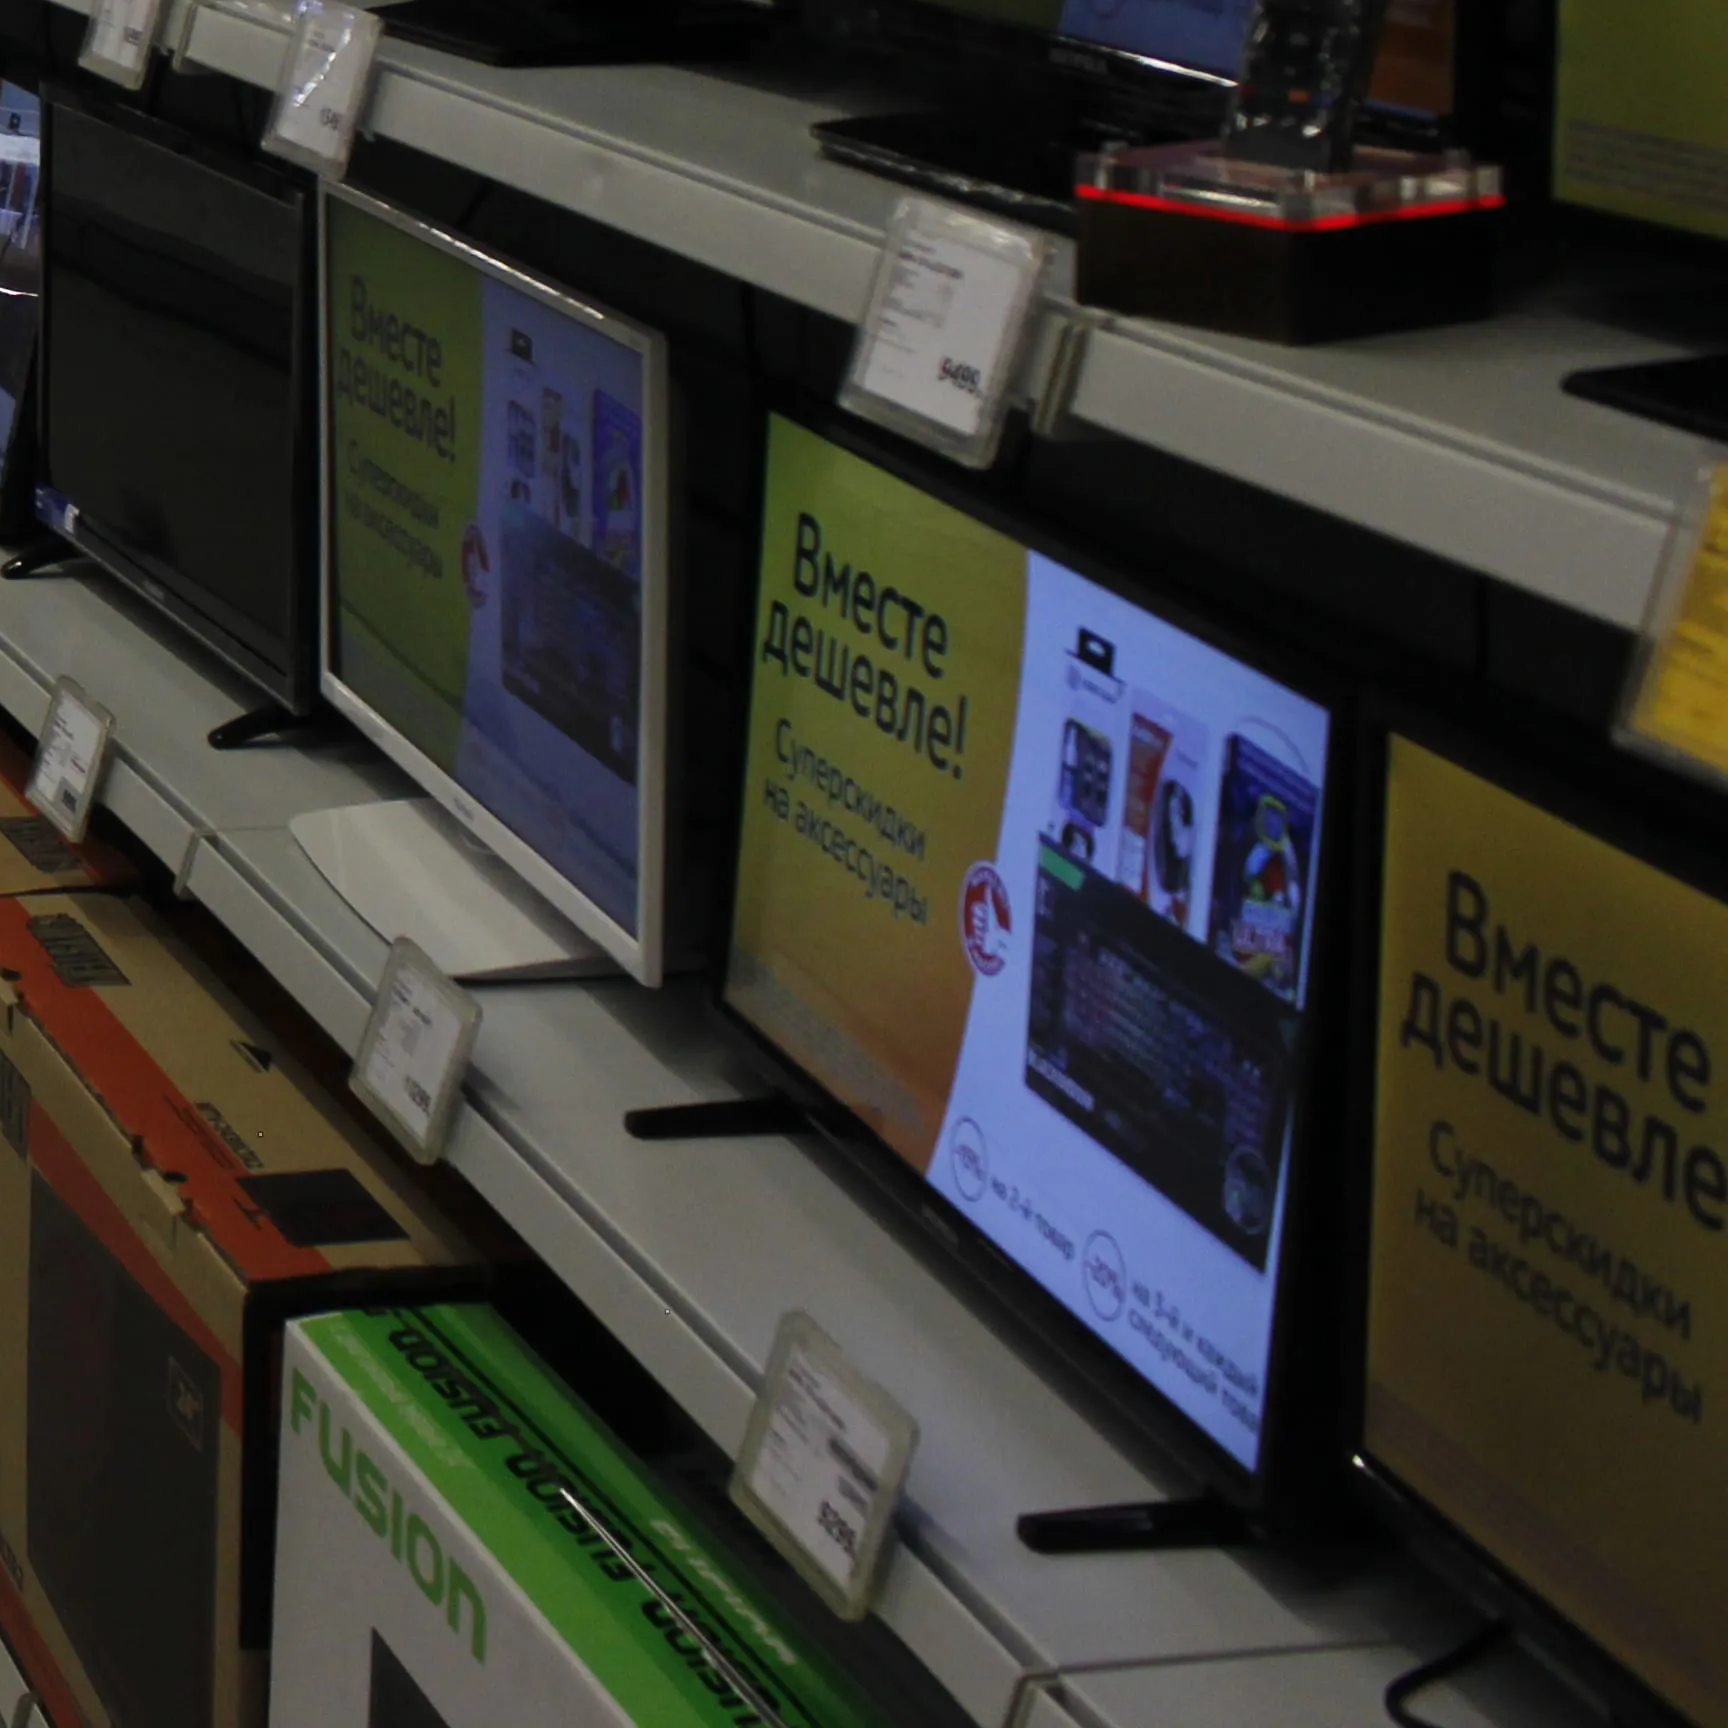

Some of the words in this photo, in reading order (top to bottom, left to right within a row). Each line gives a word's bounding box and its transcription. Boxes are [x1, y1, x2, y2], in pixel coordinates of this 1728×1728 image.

[336, 347, 457, 463] дешевле!
[350, 274, 442, 389] Вместе
[793, 512, 949, 679] Вместе
[763, 599, 969, 780] дешевле!
[763, 776, 790, 824] на
[794, 802, 929, 926] аксессуары
[775, 718, 926, 862] Суперскидки
[1446, 869, 1711, 1114] Вместе
[1401, 970, 1728, 1230] дешевле
[1413, 1189, 1459, 1249] на
[1467, 1226, 1703, 1425] аксессуары
[1428, 1120, 1692, 1341] Суперскидки
[388, 1327, 507, 1440] FUSION
[291, 1366, 487, 1665] FUSION
[504, 1452, 644, 1583] FUSION
